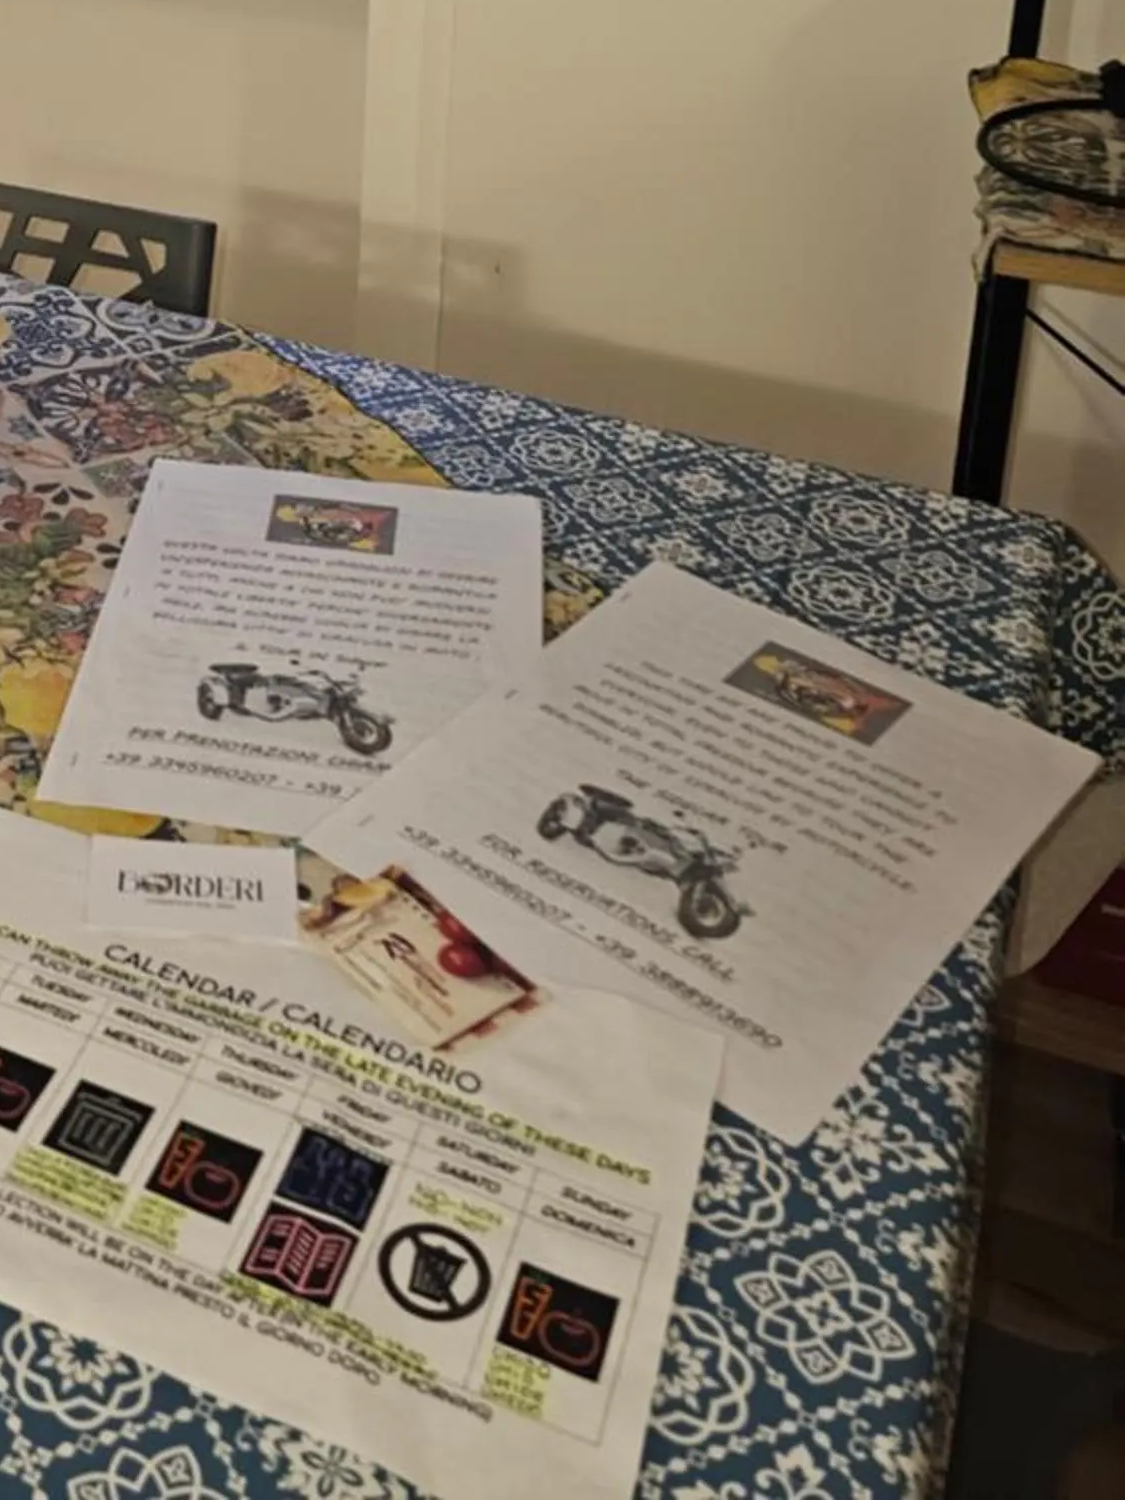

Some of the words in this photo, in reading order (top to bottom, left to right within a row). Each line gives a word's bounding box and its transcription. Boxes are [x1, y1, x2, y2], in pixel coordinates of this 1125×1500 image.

[128, 726, 165, 739] PER
[681, 946, 733, 981] CALL
[104, 944, 255, 1006] CALENDAR
[282, 1003, 481, 1093] CALENDARIO
[36, 939, 94, 968] THROW
[146, 978, 179, 999] THE
[268, 1021, 298, 1042] ON
[304, 1033, 340, 1059] THE
[344, 1053, 390, 1082] LATE
[395, 1074, 483, 1119] EVENING
[487, 1113, 515, 1130] OF
[524, 1125, 589, 1161] THESE
[595, 1154, 649, 1184] DAYS
[281, 1046, 305, 1062] LA
[311, 1056, 356, 1086] SERA
[360, 1078, 381, 1096] DI
[385, 1090, 460, 1125] QUESTI
[465, 1122, 535, 1155] GIORNI
[437, 1136, 517, 1172] SATURDAY
[438, 1162, 500, 1192] SABATO
[561, 1186, 630, 1220] SUNDAY
[541, 1205, 635, 1246] DOMENICA
[256, 1321, 324, 1356] GIORNO
[327, 1350, 380, 1385] DOPO
